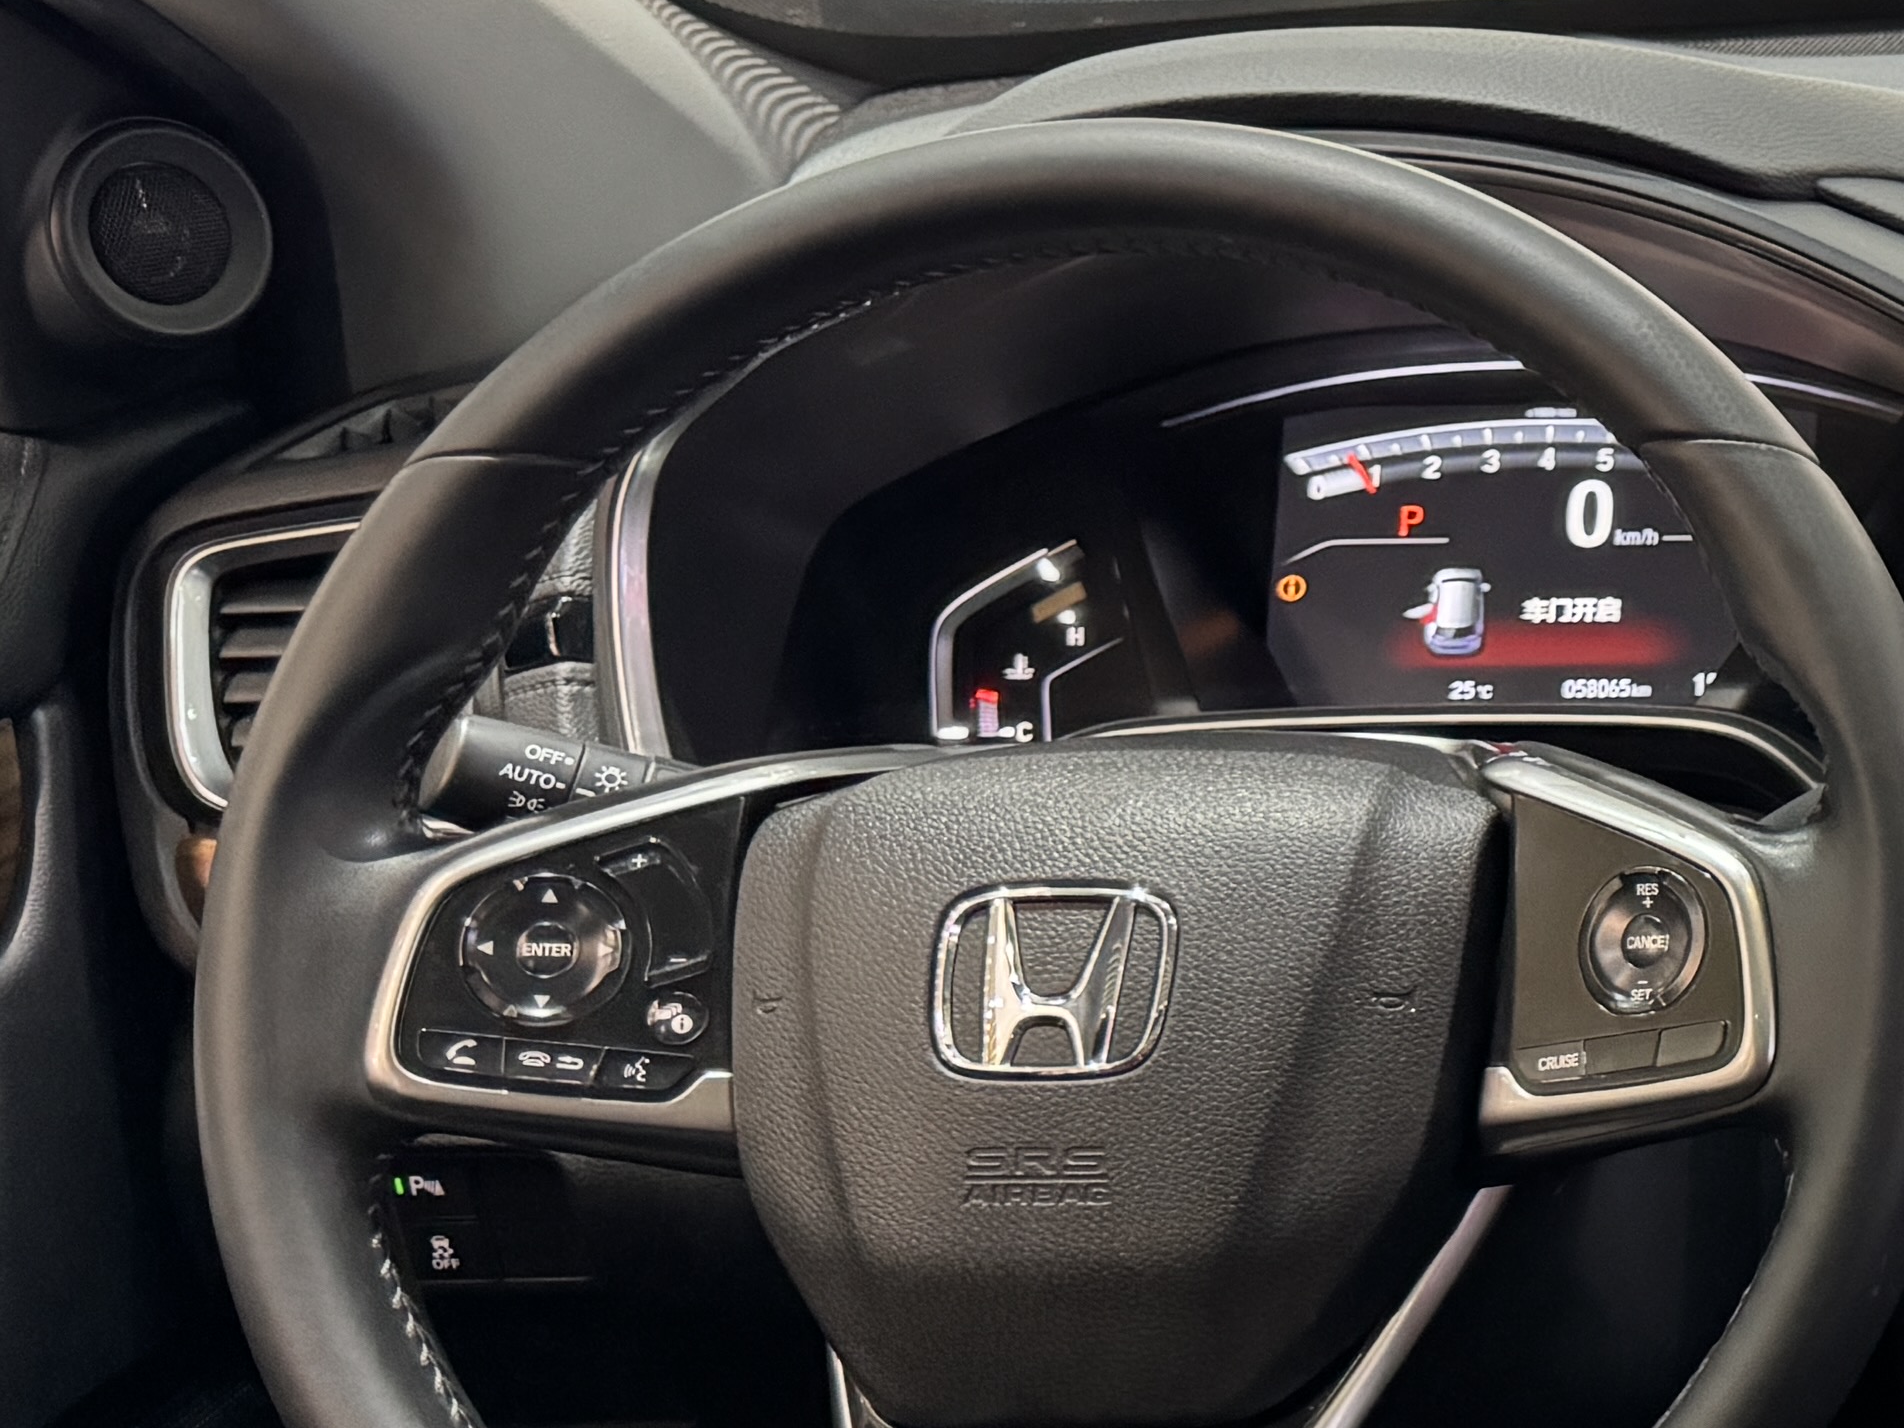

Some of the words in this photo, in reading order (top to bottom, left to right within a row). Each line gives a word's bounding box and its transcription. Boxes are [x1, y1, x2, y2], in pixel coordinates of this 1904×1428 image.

[1423, 455, 1443, 480] 2
[1480, 449, 1501, 473] 3
[1537, 447, 1557, 471] 4
[1595, 448, 1614, 472] 5
[1398, 505, 1425, 536] P
[1564, 478, 1614, 549] 0
[1521, 597, 1622, 624] 车门开启
[1065, 625, 1085, 647] H
[524, 743, 566, 765] OFF
[499, 763, 557, 791] AUTO
[1636, 883, 1659, 896] RES
[521, 942, 573, 958] ENTER
[1630, 988, 1652, 1002] SET
[1538, 1052, 1579, 1071] CRUISE
